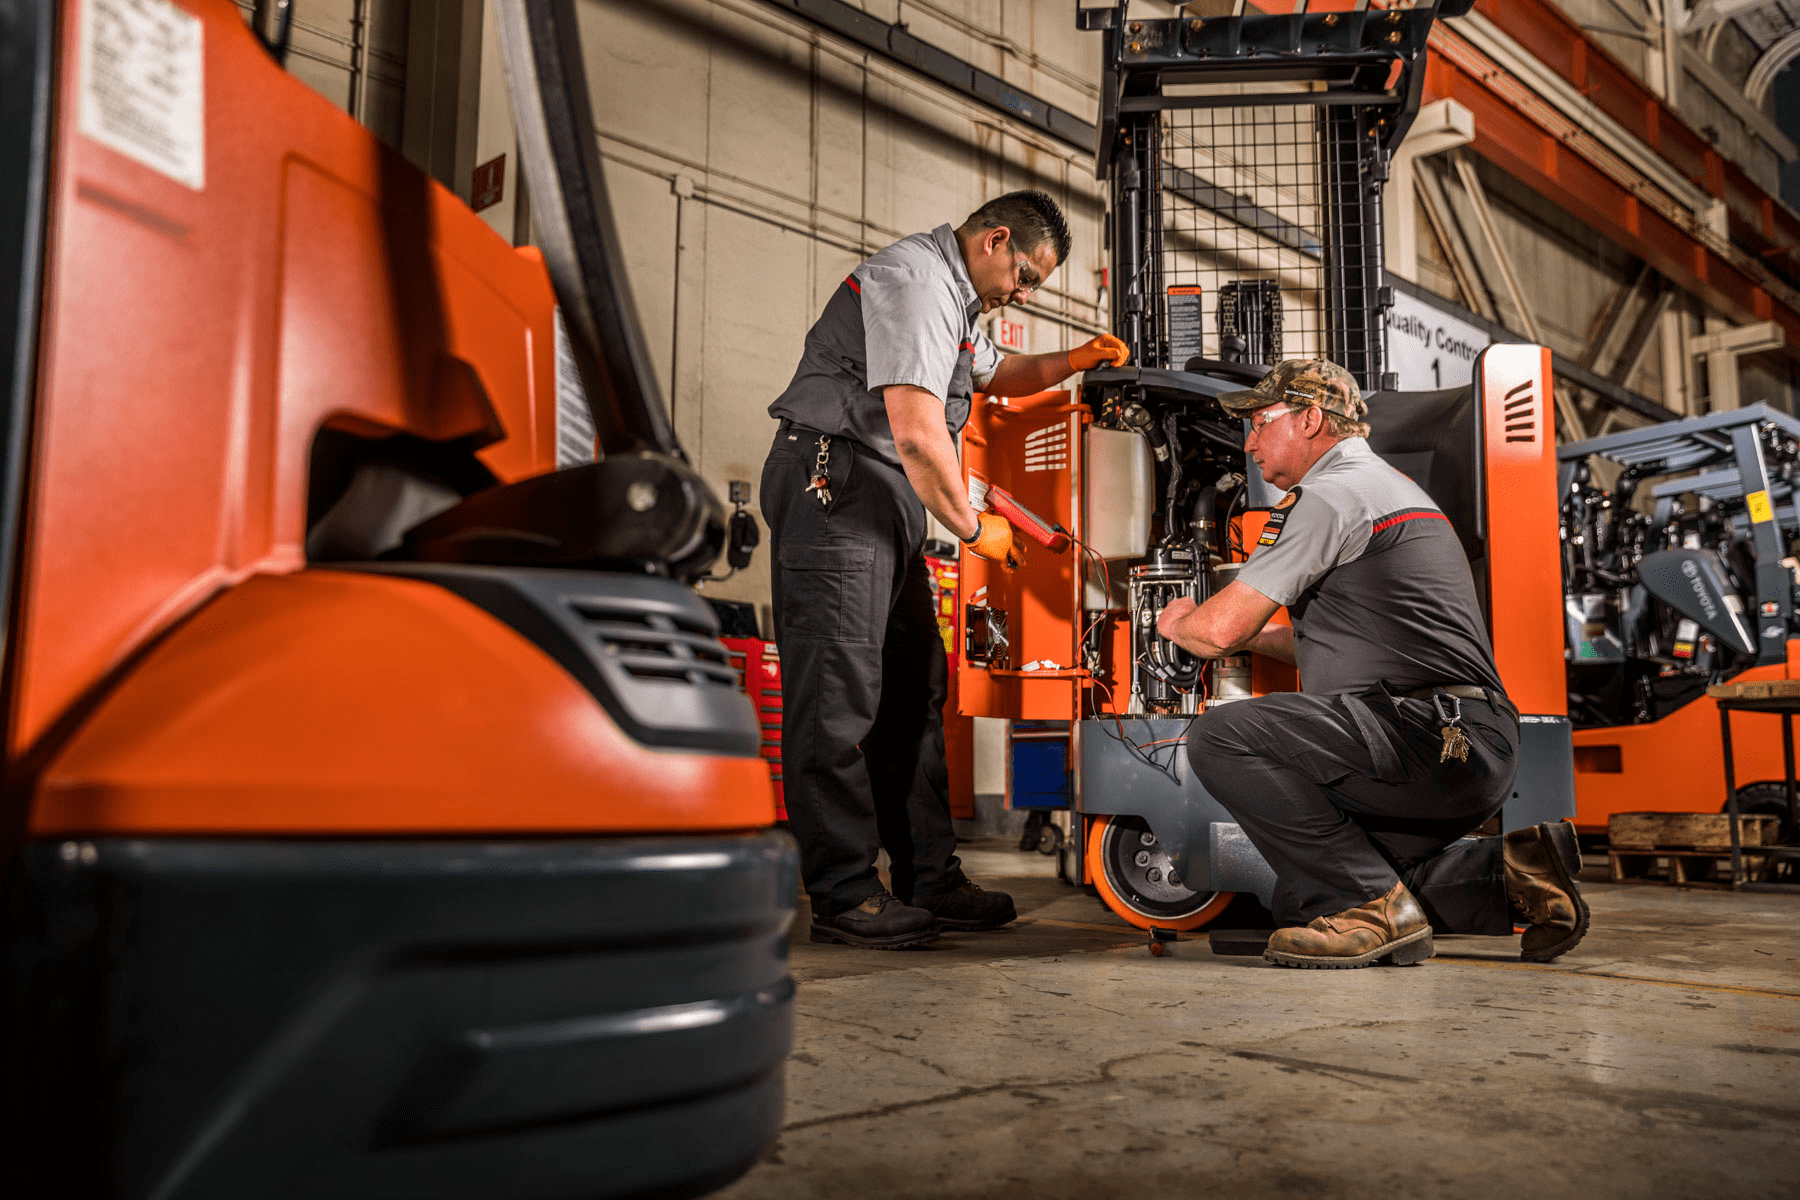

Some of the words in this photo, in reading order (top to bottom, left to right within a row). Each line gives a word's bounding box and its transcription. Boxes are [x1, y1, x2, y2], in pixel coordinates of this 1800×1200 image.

[1001, 319, 1024, 349] EXIT
[1431, 358, 1440, 388] 1
[1690, 576, 1718, 621] TOYOTA
